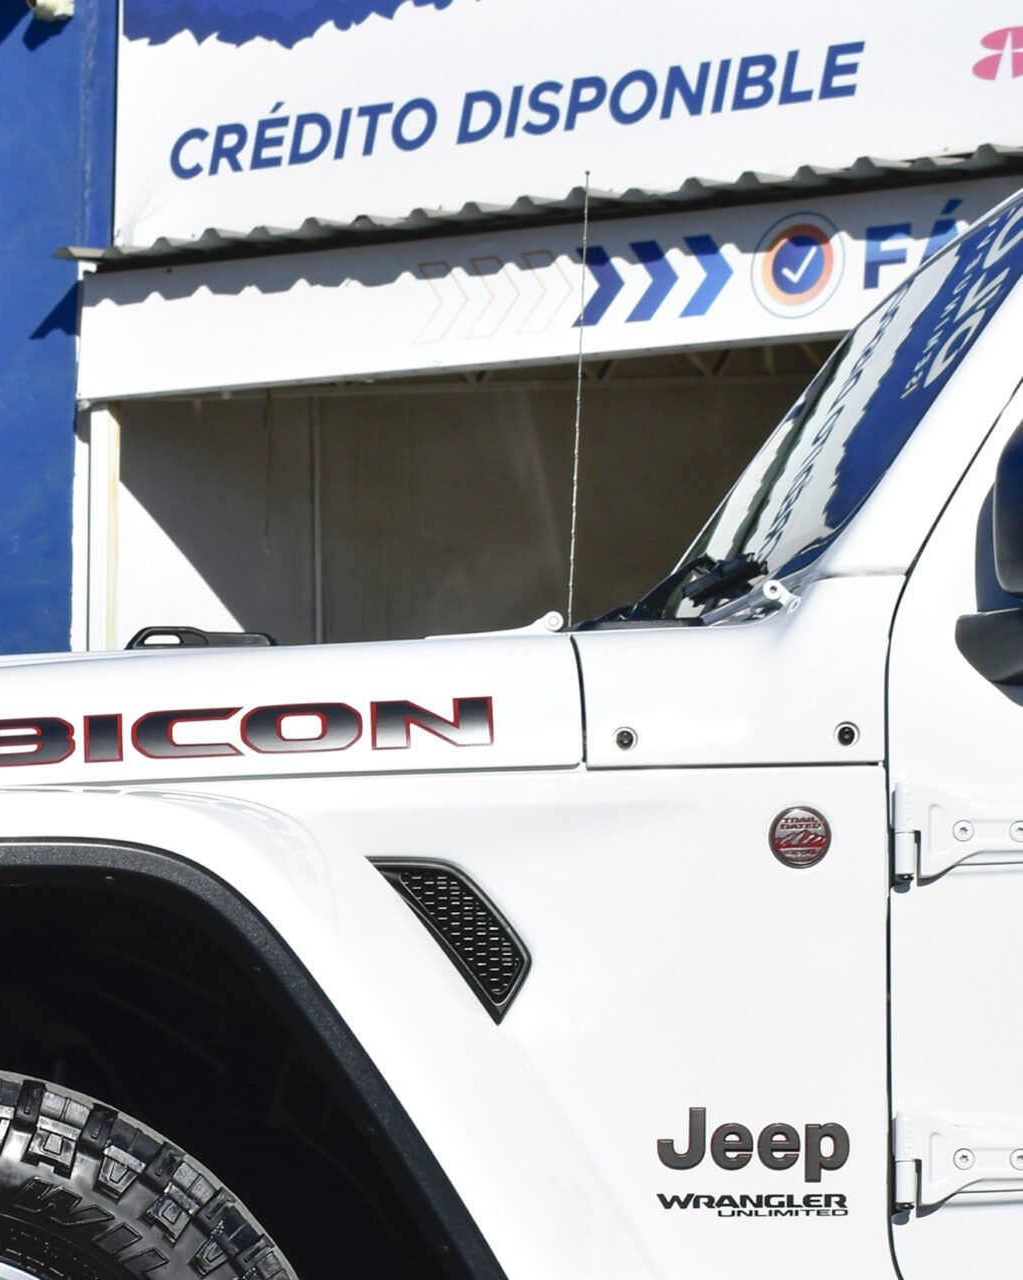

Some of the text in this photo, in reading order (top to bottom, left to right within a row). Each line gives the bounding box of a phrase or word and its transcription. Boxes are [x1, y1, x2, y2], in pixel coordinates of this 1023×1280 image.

[170, 41, 865, 180] CRÉDITO DISPONIBLE
[657, 1106, 850, 1183] Jeep
[656, 1193, 848, 1210] WRANGLER
[718, 1209, 849, 1218] UNLIMITED
